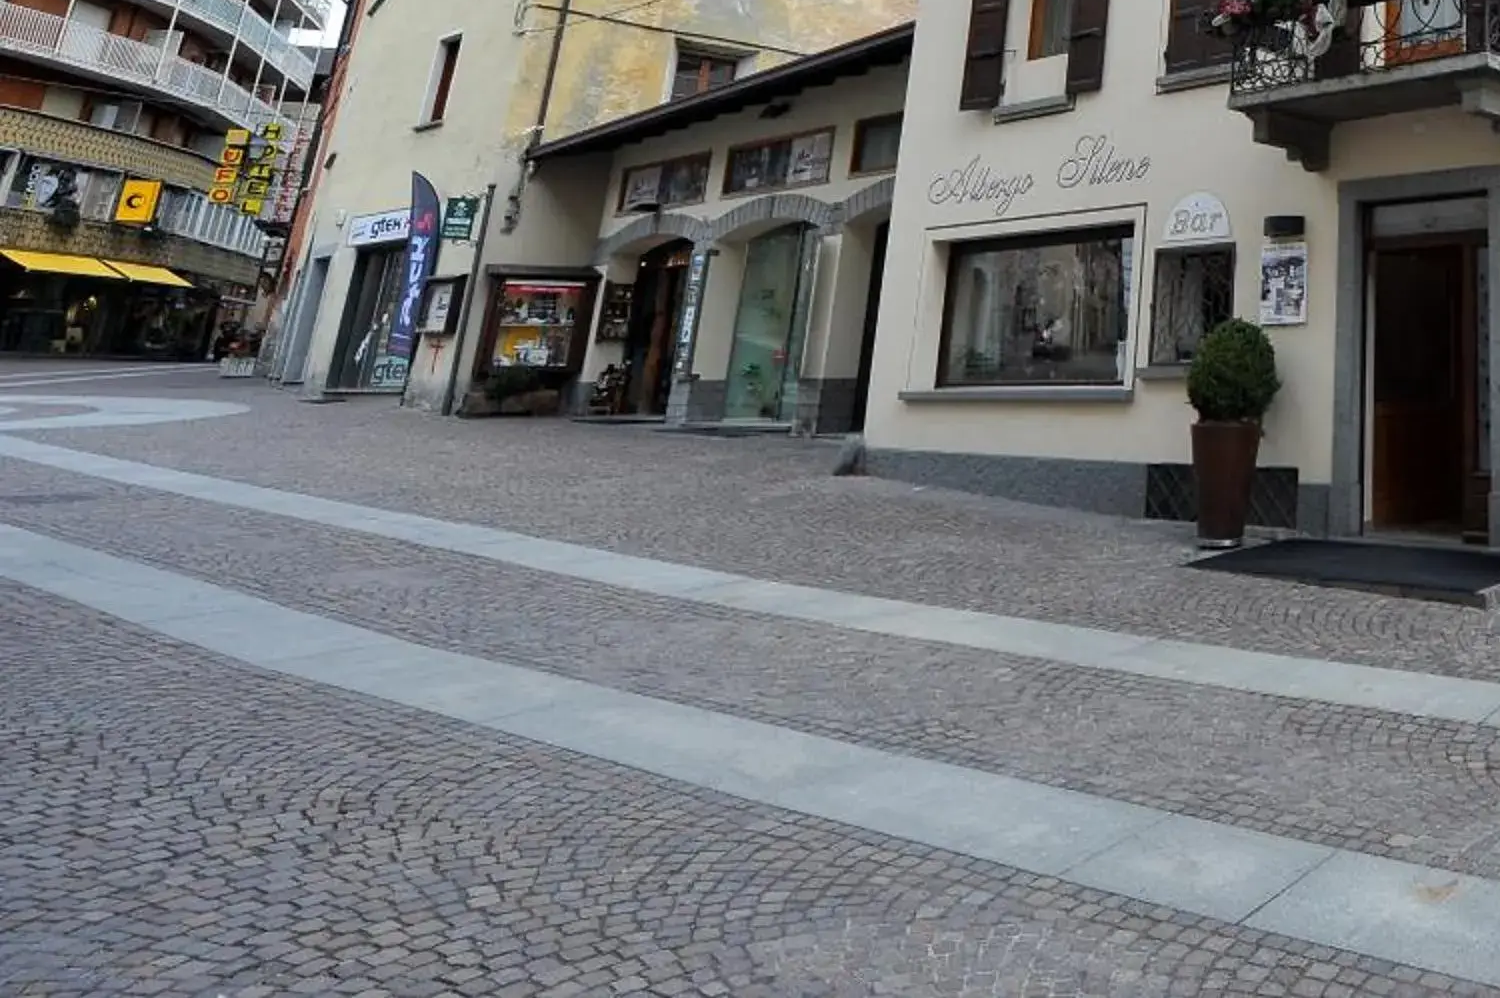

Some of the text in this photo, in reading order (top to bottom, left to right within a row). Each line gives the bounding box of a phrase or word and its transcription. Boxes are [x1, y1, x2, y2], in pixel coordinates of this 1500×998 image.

[241, 123, 281, 214] HOTEL
[927, 135, 1151, 215] Albergo Silene
